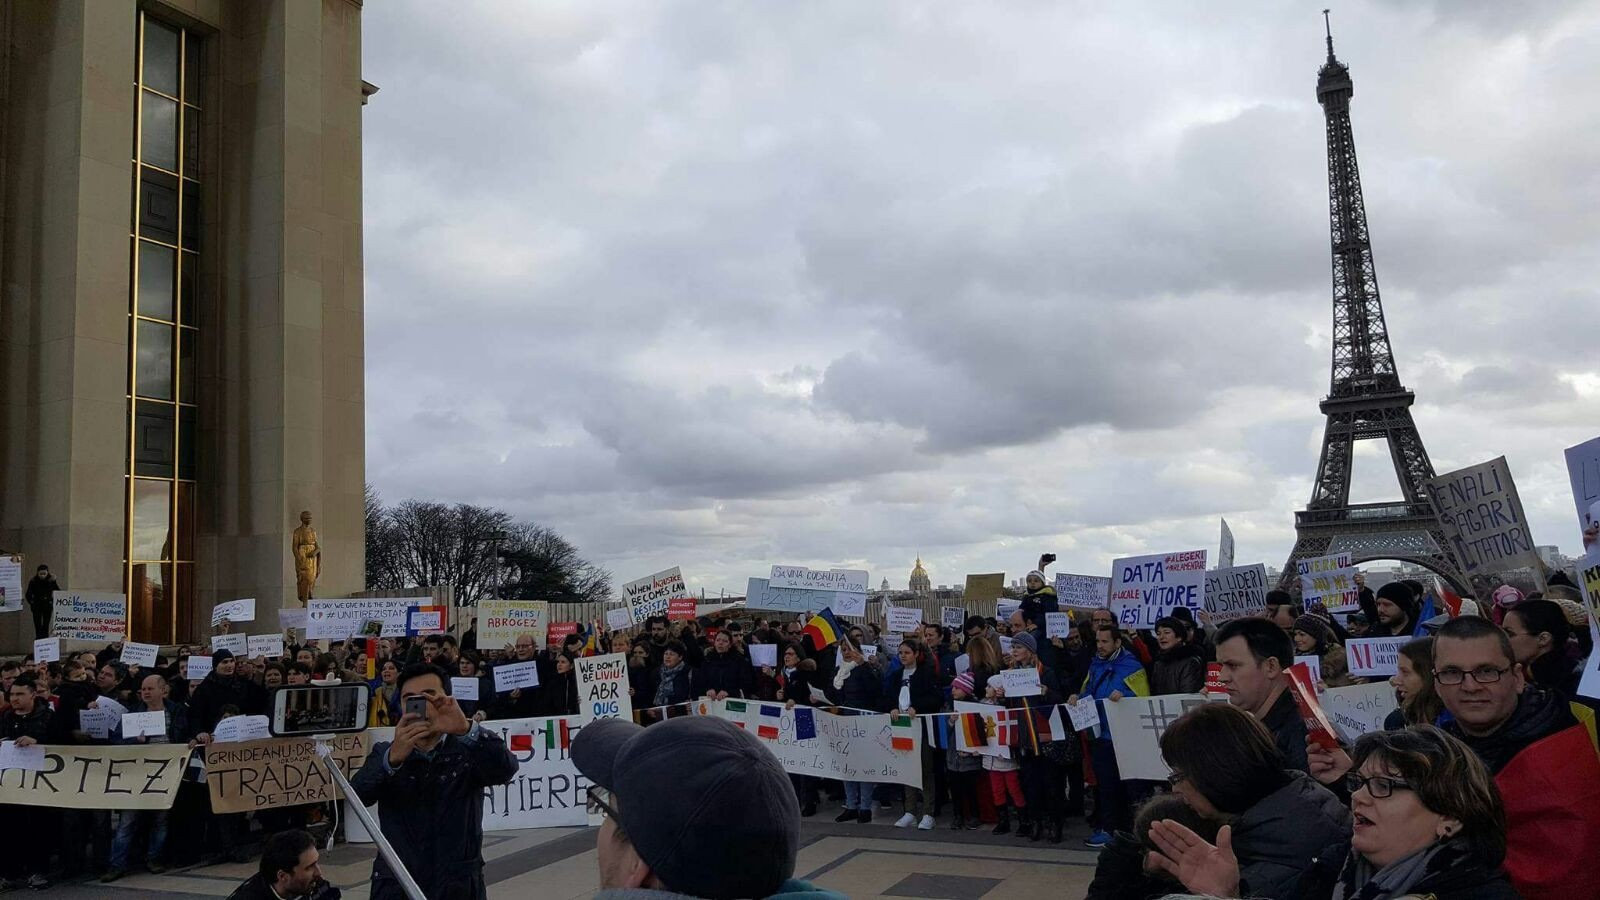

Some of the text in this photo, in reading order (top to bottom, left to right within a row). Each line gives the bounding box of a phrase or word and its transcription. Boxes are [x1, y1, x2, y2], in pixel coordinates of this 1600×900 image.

[1123, 561, 1164, 583] DATA
[1227, 567, 1264, 589] LIDERI
[626, 584, 652, 596] WHEN
[631, 582, 686, 607] BECOMES LAW
[1112, 589, 1140, 600] #LOCALE
[508, 610, 534, 618] FAITS
[488, 618, 537, 628] ABROGEZ
[1351, 644, 1377, 669] NU
[579, 659, 621, 673] WE DON'T
[583, 673, 594, 683] BE
[588, 682, 619, 701] ABR
[593, 701, 619, 716] OUG
[831, 719, 866, 739] Ucide
[842, 763, 857, 777] day
[863, 767, 876, 776] we
[881, 764, 899, 777] die
[255, 793, 277, 806] DE
